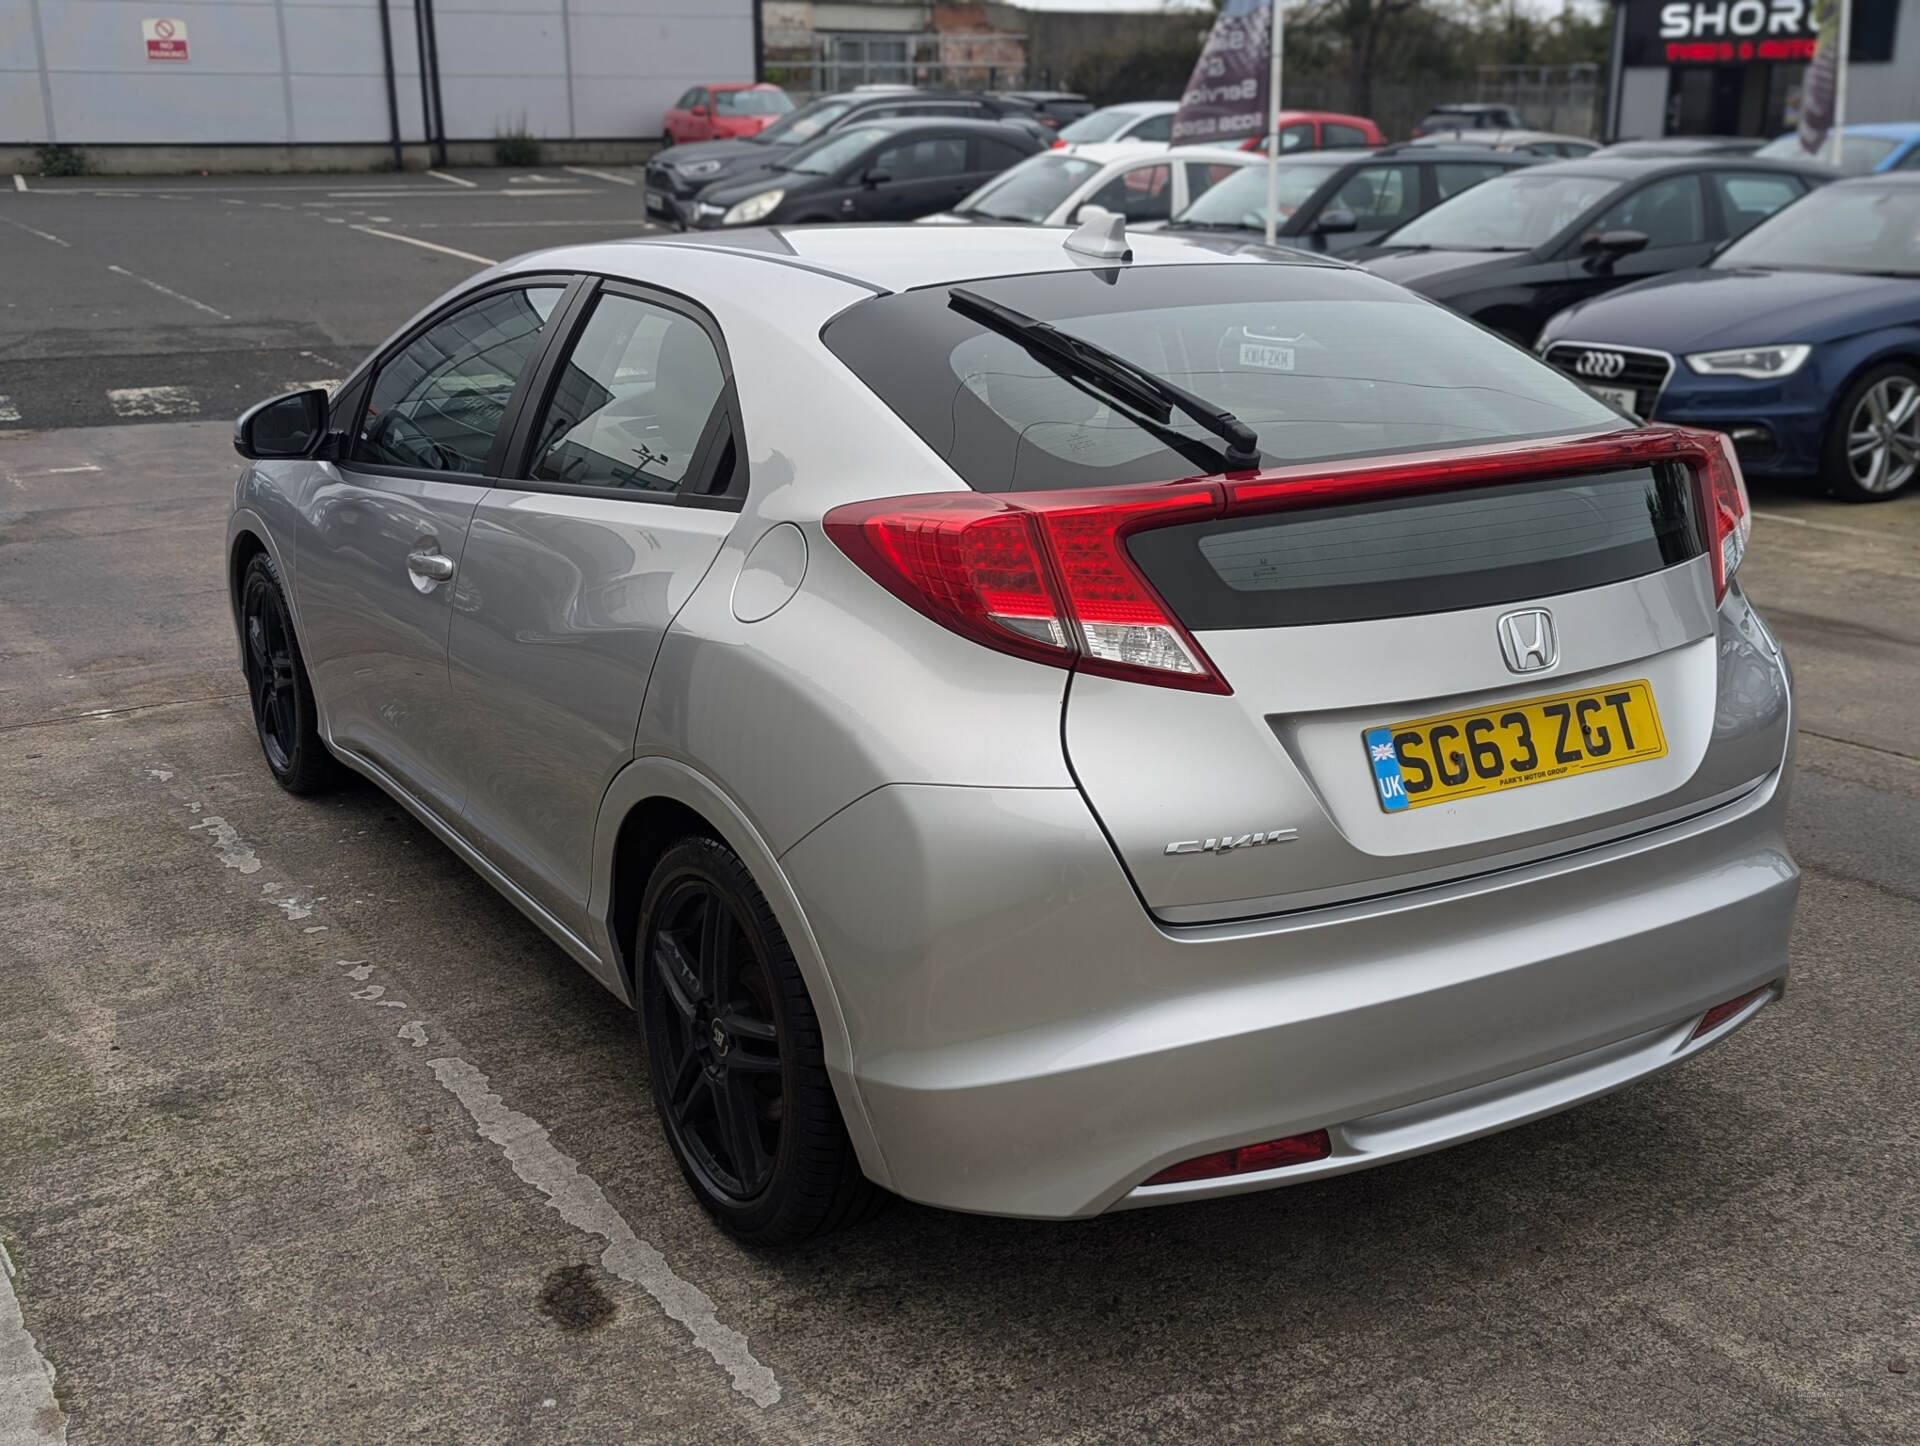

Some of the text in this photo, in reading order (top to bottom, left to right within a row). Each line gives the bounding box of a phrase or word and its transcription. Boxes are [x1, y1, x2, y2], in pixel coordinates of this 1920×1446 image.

[149, 50, 186, 58] PARKING
[1393, 692, 1636, 793] SG63 ZGT
[1379, 774, 1405, 799] UK
[1499, 766, 1568, 786] PARK'S MOTOR GROUP
[1163, 827, 1300, 856] CIVIC
